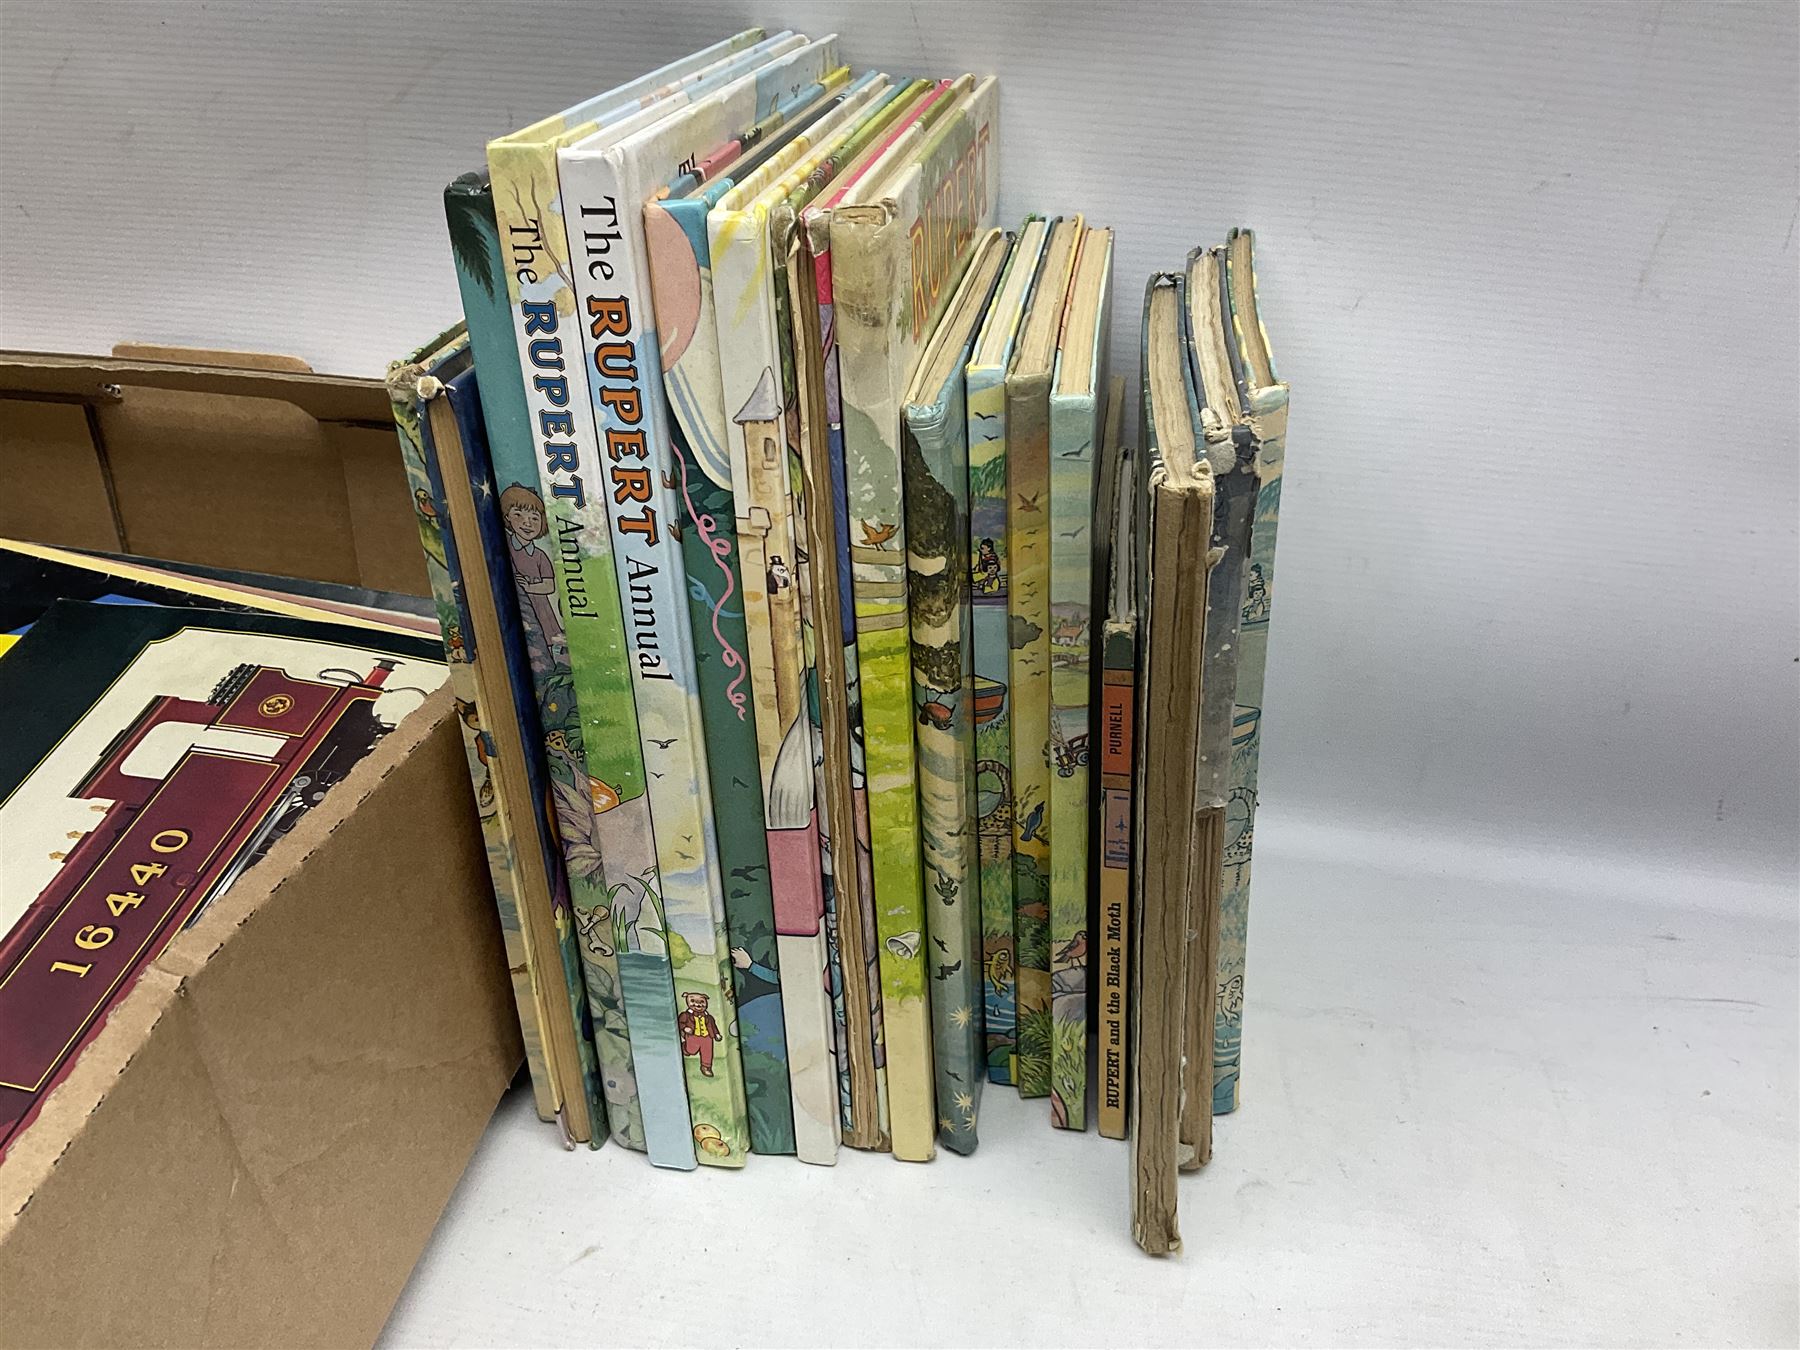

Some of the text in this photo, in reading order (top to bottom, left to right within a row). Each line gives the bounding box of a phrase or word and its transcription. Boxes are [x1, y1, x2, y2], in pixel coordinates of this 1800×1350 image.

[908, 121, 990, 345] RUPERT
[509, 218, 598, 618] The RUPERT Annual
[580, 195, 674, 680] The RUPERT Annual
[1109, 703, 1123, 755] PURNELL
[50, 829, 189, 978] 16440
[1106, 902, 1121, 1109] RUPERT and the Black Moth
